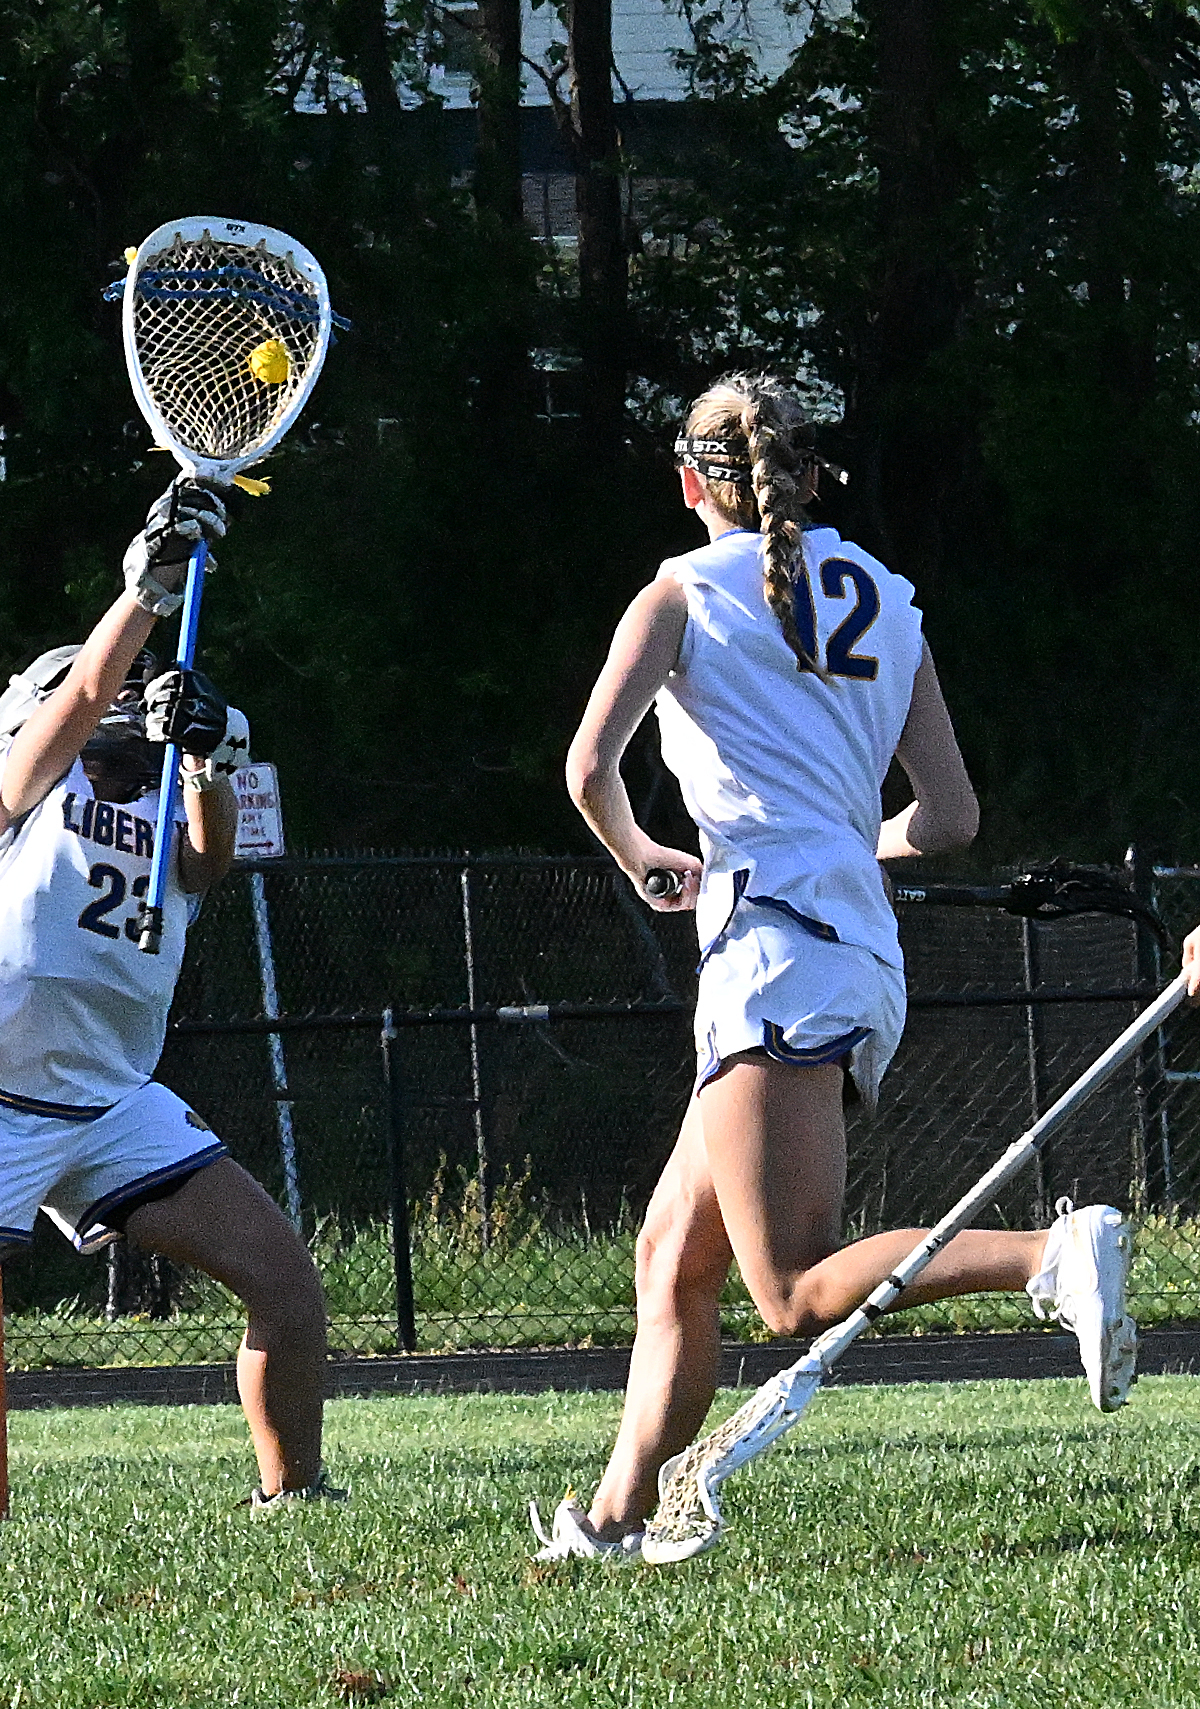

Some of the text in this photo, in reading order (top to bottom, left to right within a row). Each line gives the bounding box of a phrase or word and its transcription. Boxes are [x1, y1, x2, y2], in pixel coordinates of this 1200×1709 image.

[693, 440, 728, 453] STX
[236, 772, 259, 790] NO
[62, 792, 156, 859] LIBER
